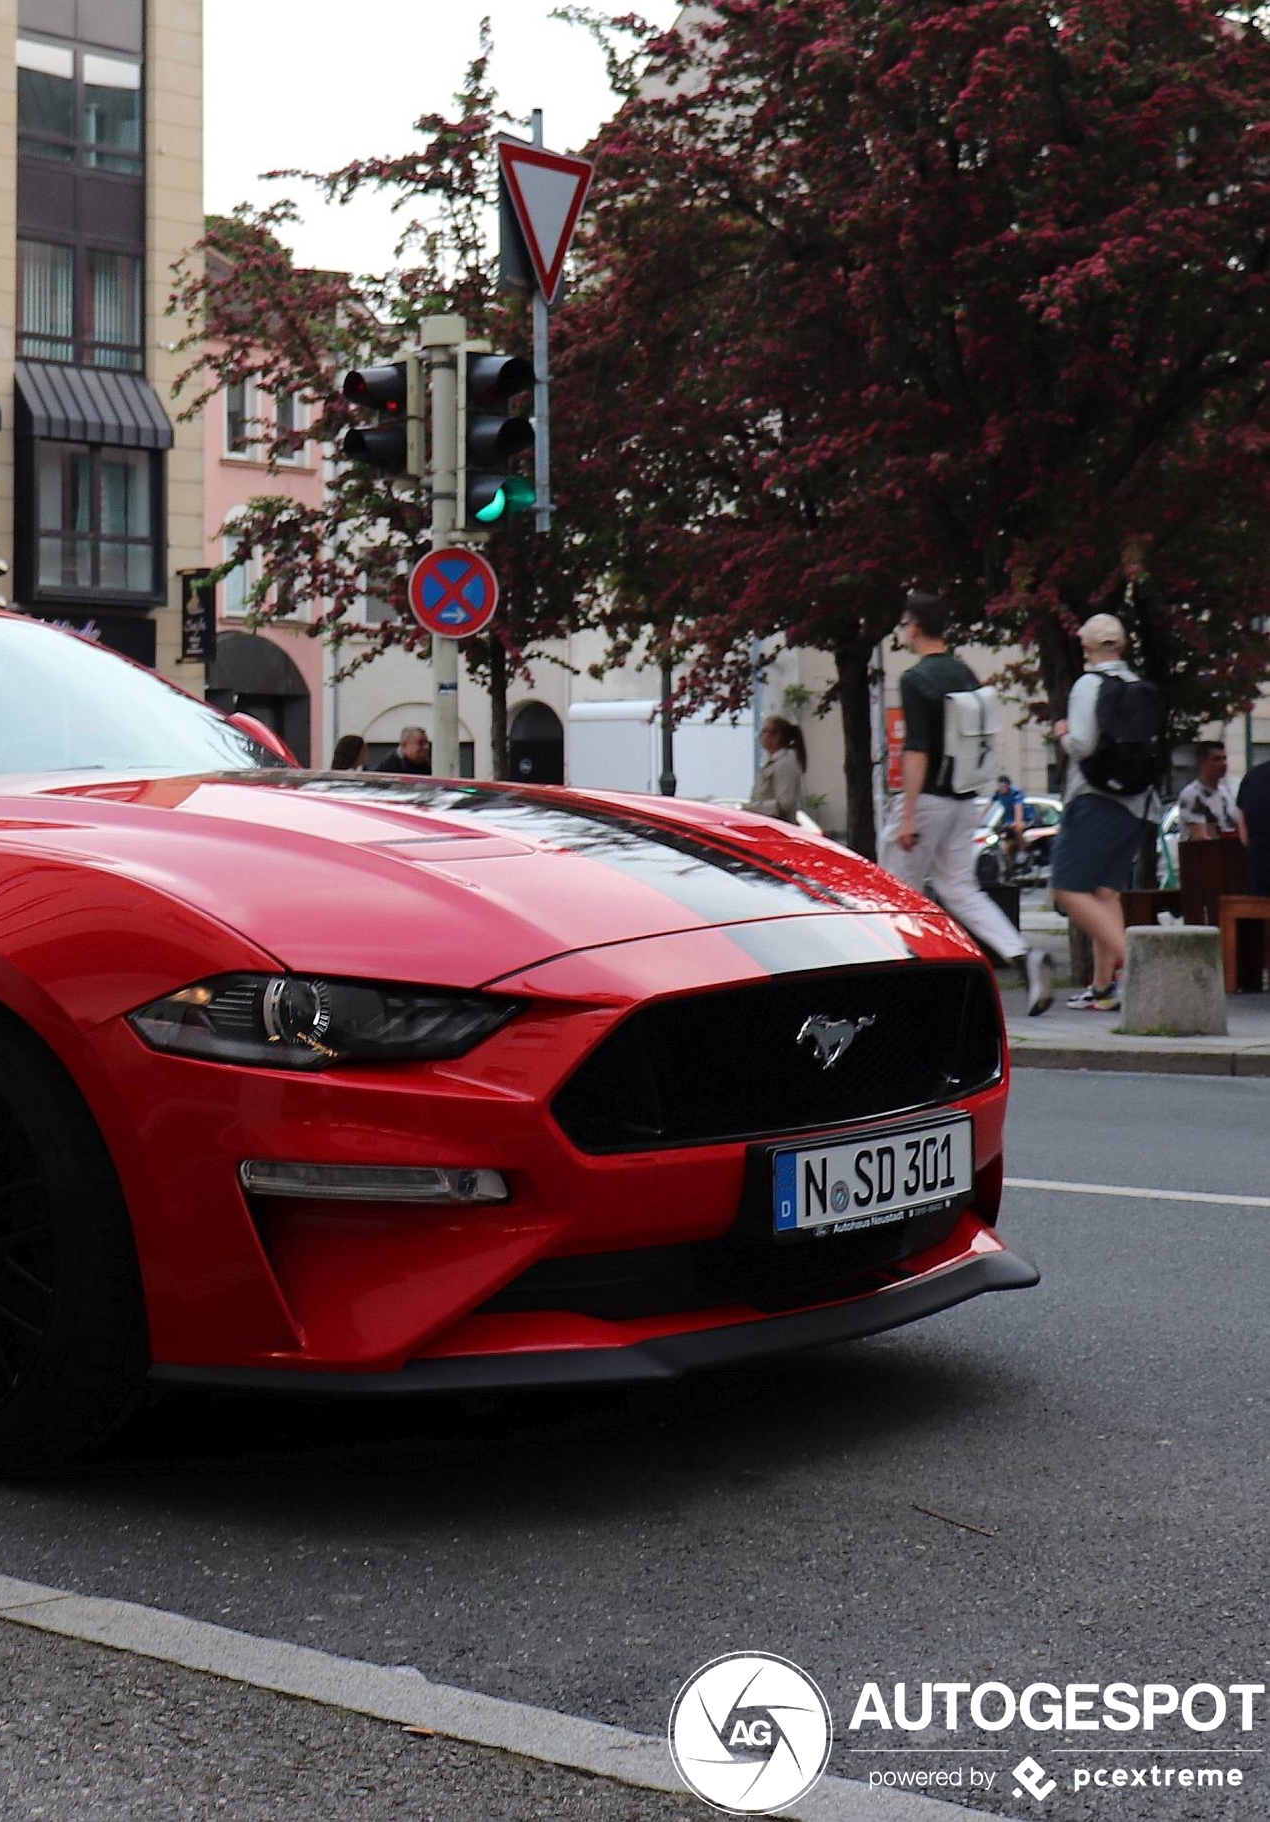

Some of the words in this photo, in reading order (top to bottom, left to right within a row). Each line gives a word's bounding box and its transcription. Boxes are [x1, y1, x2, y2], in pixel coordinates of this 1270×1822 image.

[805, 1157, 827, 1217] N
[854, 1145, 896, 1207] SD
[904, 1133, 955, 1196] 301
[781, 1200, 791, 1218] D
